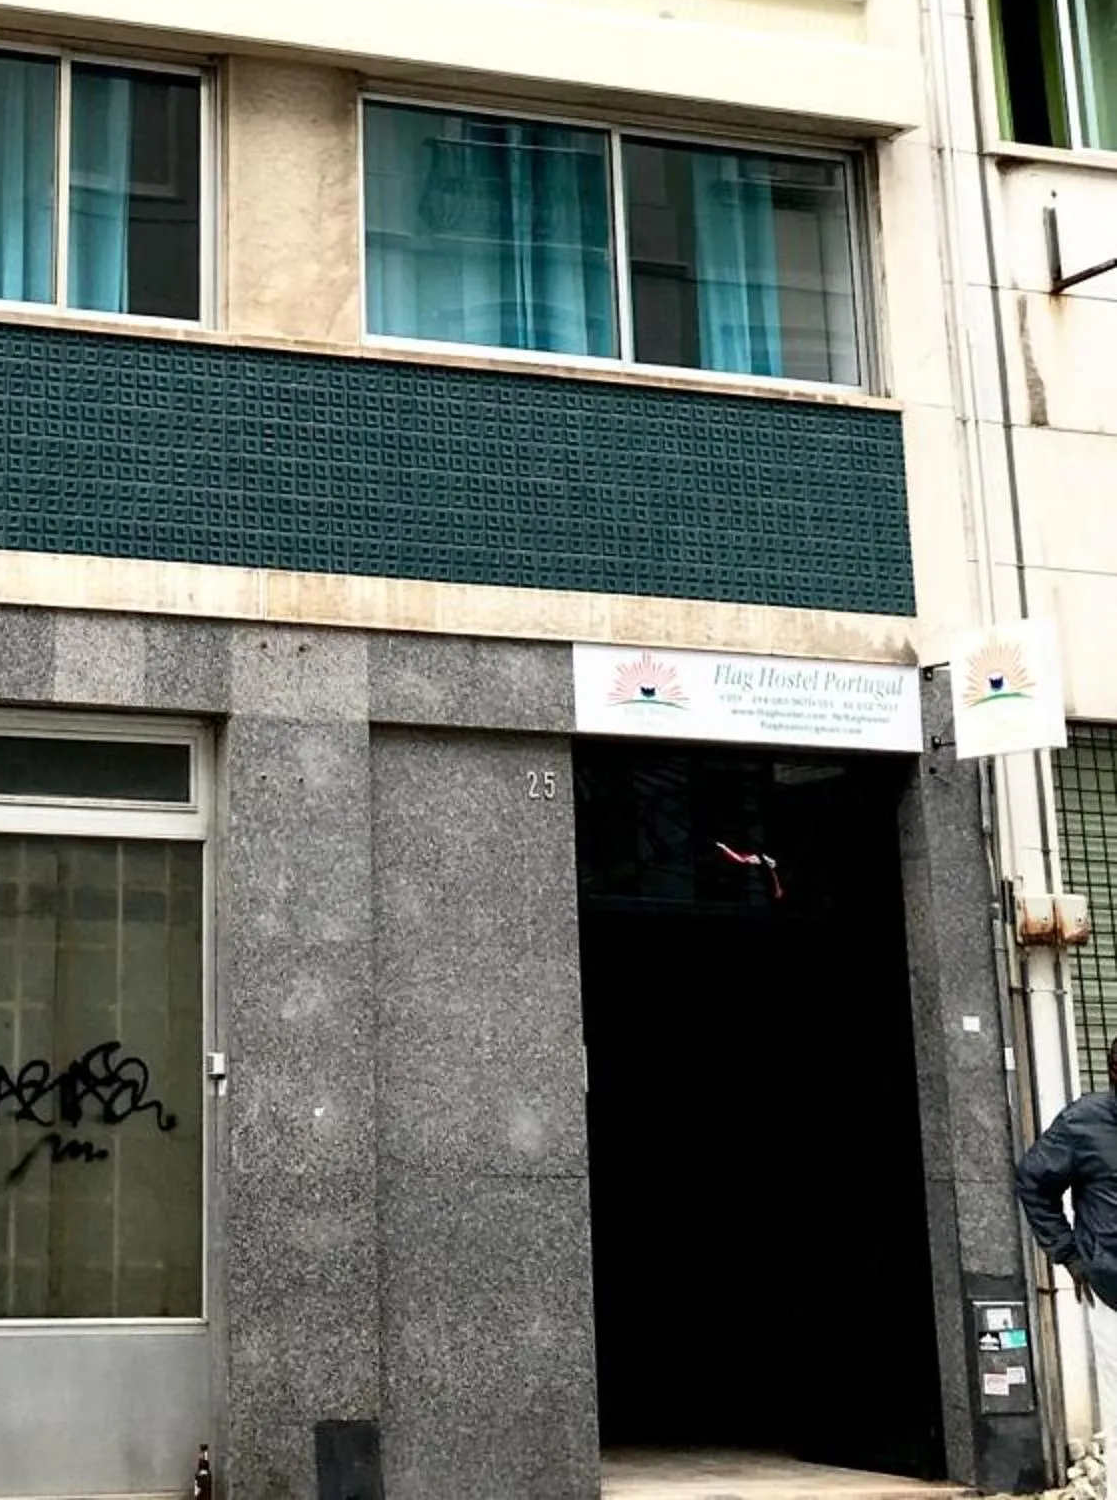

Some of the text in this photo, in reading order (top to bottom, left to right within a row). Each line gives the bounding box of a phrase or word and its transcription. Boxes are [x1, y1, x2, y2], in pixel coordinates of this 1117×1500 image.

[714, 663, 905, 701] Flag Hostel Portugal
[526, 771, 556, 799] 25
